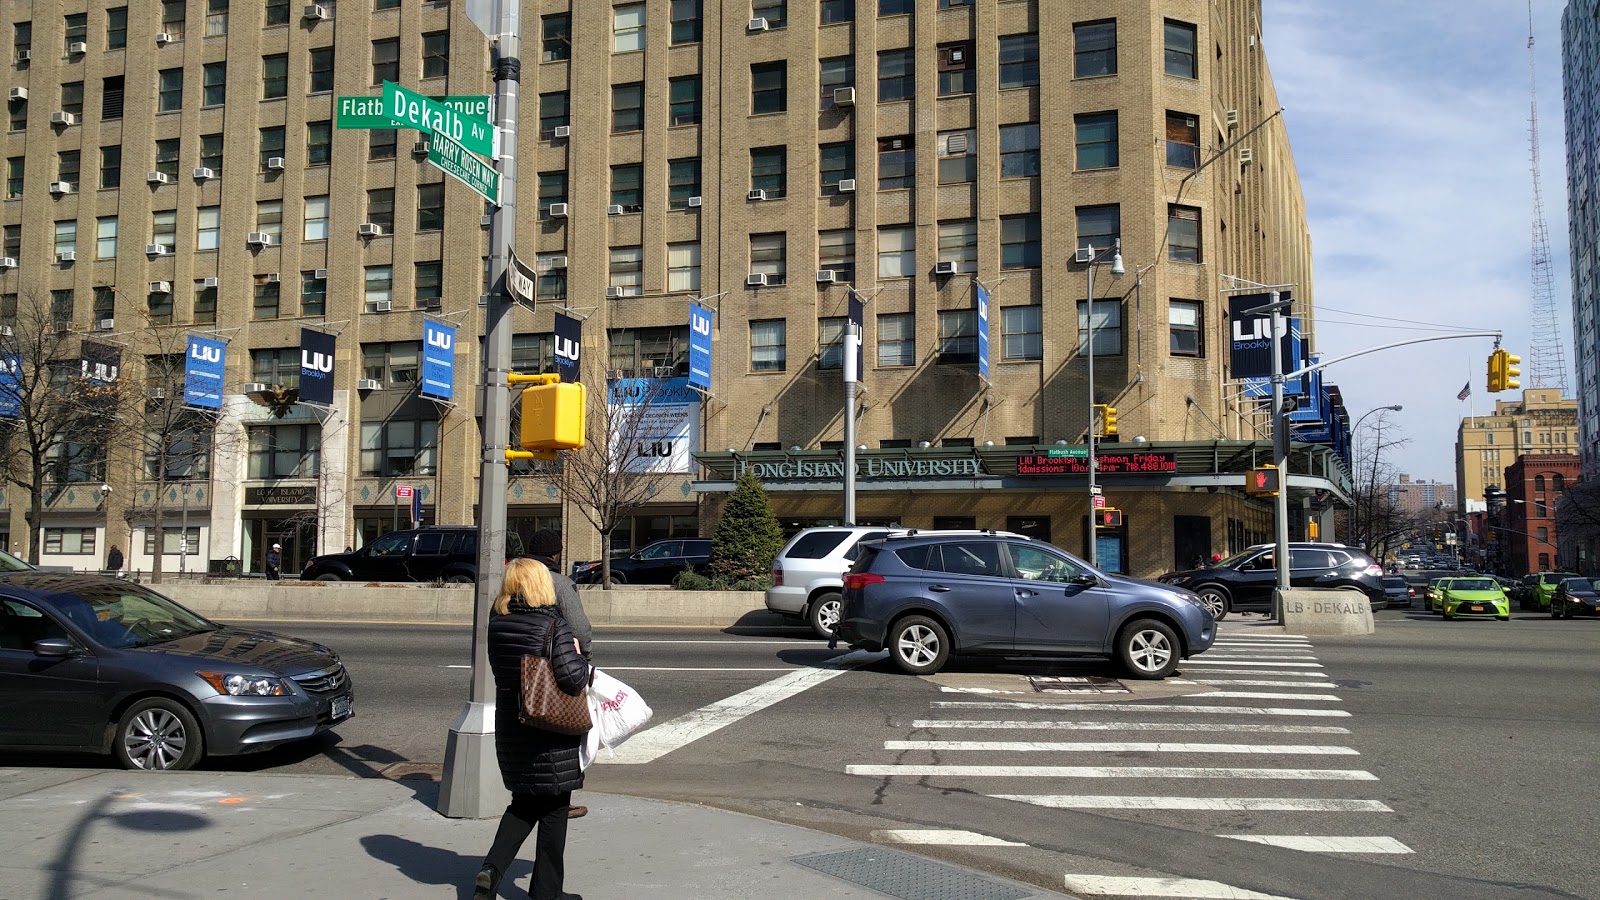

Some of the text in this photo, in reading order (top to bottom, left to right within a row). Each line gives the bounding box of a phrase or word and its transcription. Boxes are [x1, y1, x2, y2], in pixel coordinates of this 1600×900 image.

[343, 99, 383, 116] Flatb
[394, 89, 485, 141] Dekalb Av
[433, 131, 495, 189] HARRY ROSEN WAY
[441, 156, 470, 183] CHEESECAKE
[693, 313, 710, 336] LIU
[1233, 317, 1288, 341] LIU
[428, 328, 451, 350] LIU
[555, 334, 579, 361] LIU
[1233, 340, 1272, 350] Brookly
[192, 343, 221, 363] LIU
[302, 349, 333, 373] LIU
[81, 359, 118, 382] LIU
[301, 367, 326, 380] Brooklyn
[637, 441, 673, 458] LIU
[1133, 453, 1165, 463] Friday
[867, 458, 983, 477] UNIVERSITY
